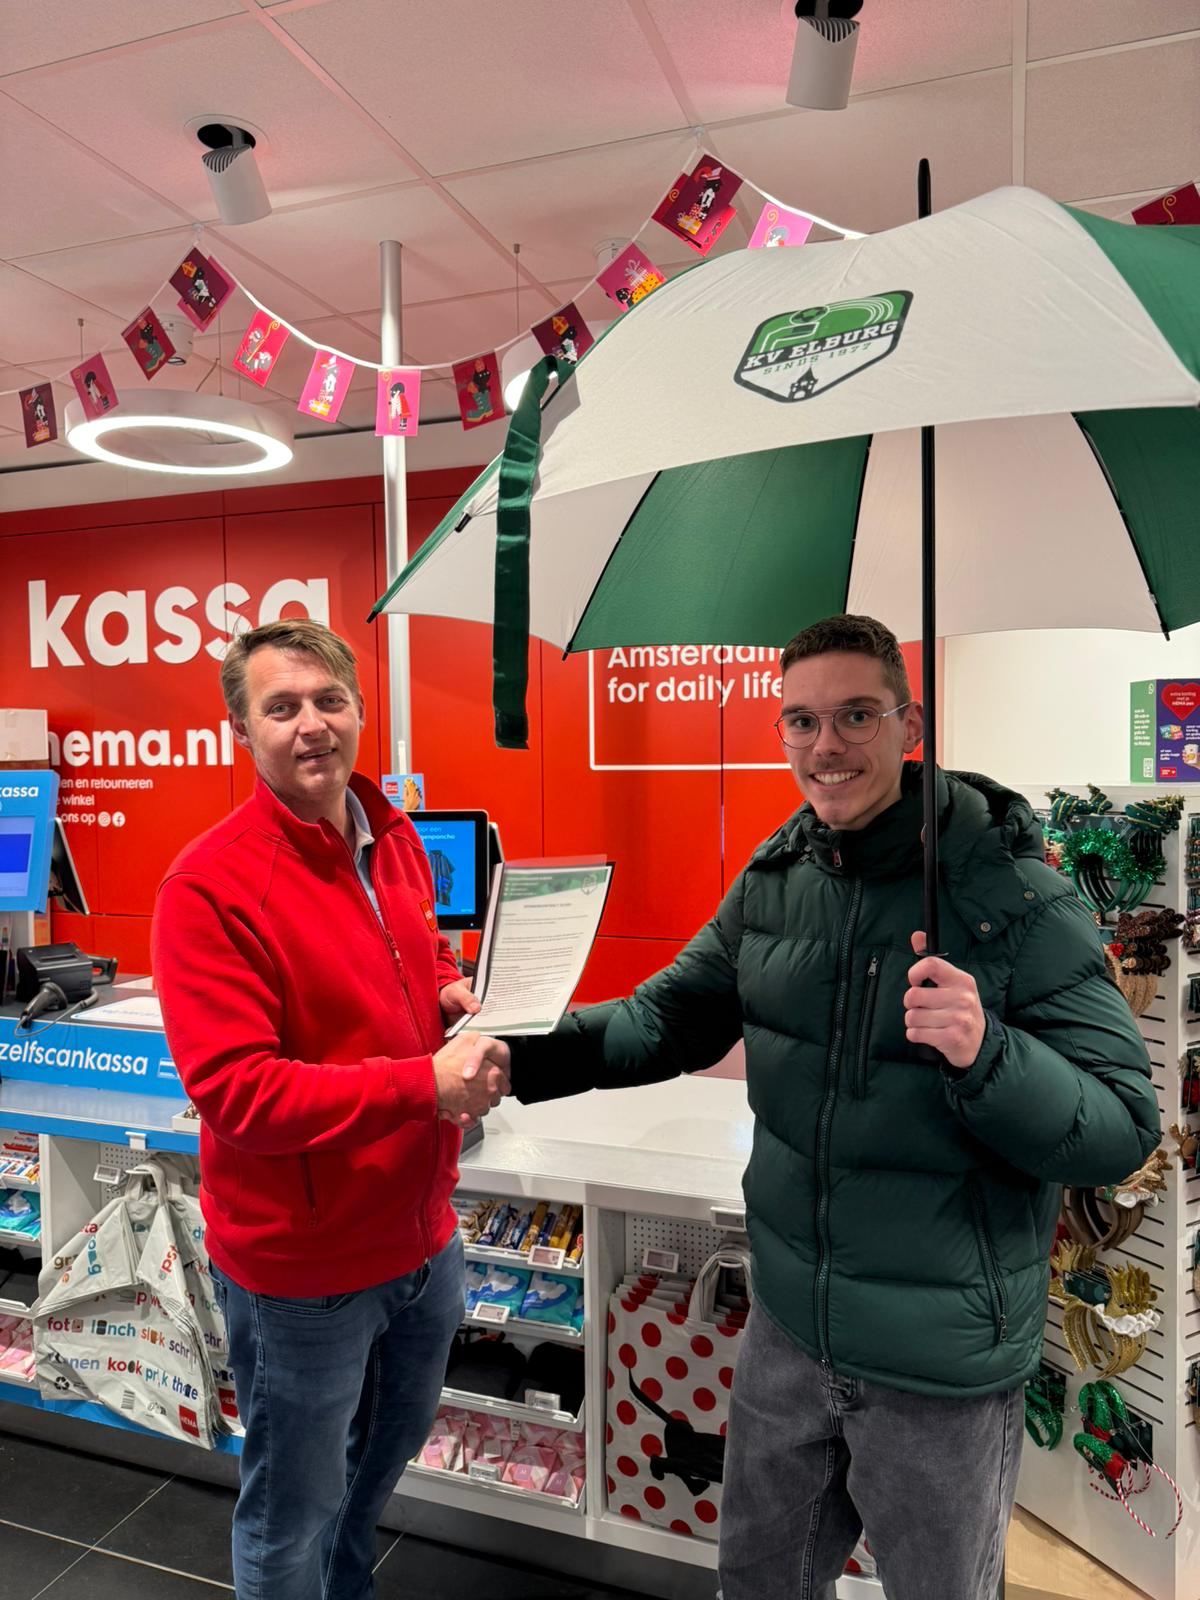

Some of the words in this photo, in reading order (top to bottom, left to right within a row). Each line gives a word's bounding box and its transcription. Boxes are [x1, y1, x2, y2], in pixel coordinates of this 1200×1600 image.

[744, 350, 785, 370] KV
[788, 320, 899, 359] ELBURG
[762, 355, 819, 376] SINDS
[828, 342, 873, 359] 1977
[28, 578, 330, 668] kassa
[607, 644, 785, 669] Amsterdam
[607, 677, 650, 704] for
[656, 674, 736, 707] daily
[743, 670, 783, 699] life
[75, 778, 89, 789] en
[91, 777, 153, 789] retourneren
[64, 795, 95, 806] winkel
[61, 814, 79, 824] ons
[80, 813, 96, 827] op
[0, 1041, 149, 1075] zelfscankassa
[47, 1316, 83, 1333] fot
[91, 1319, 136, 1337] lnch
[108, 1356, 142, 1375] kok
[172, 1376, 198, 1400] the
